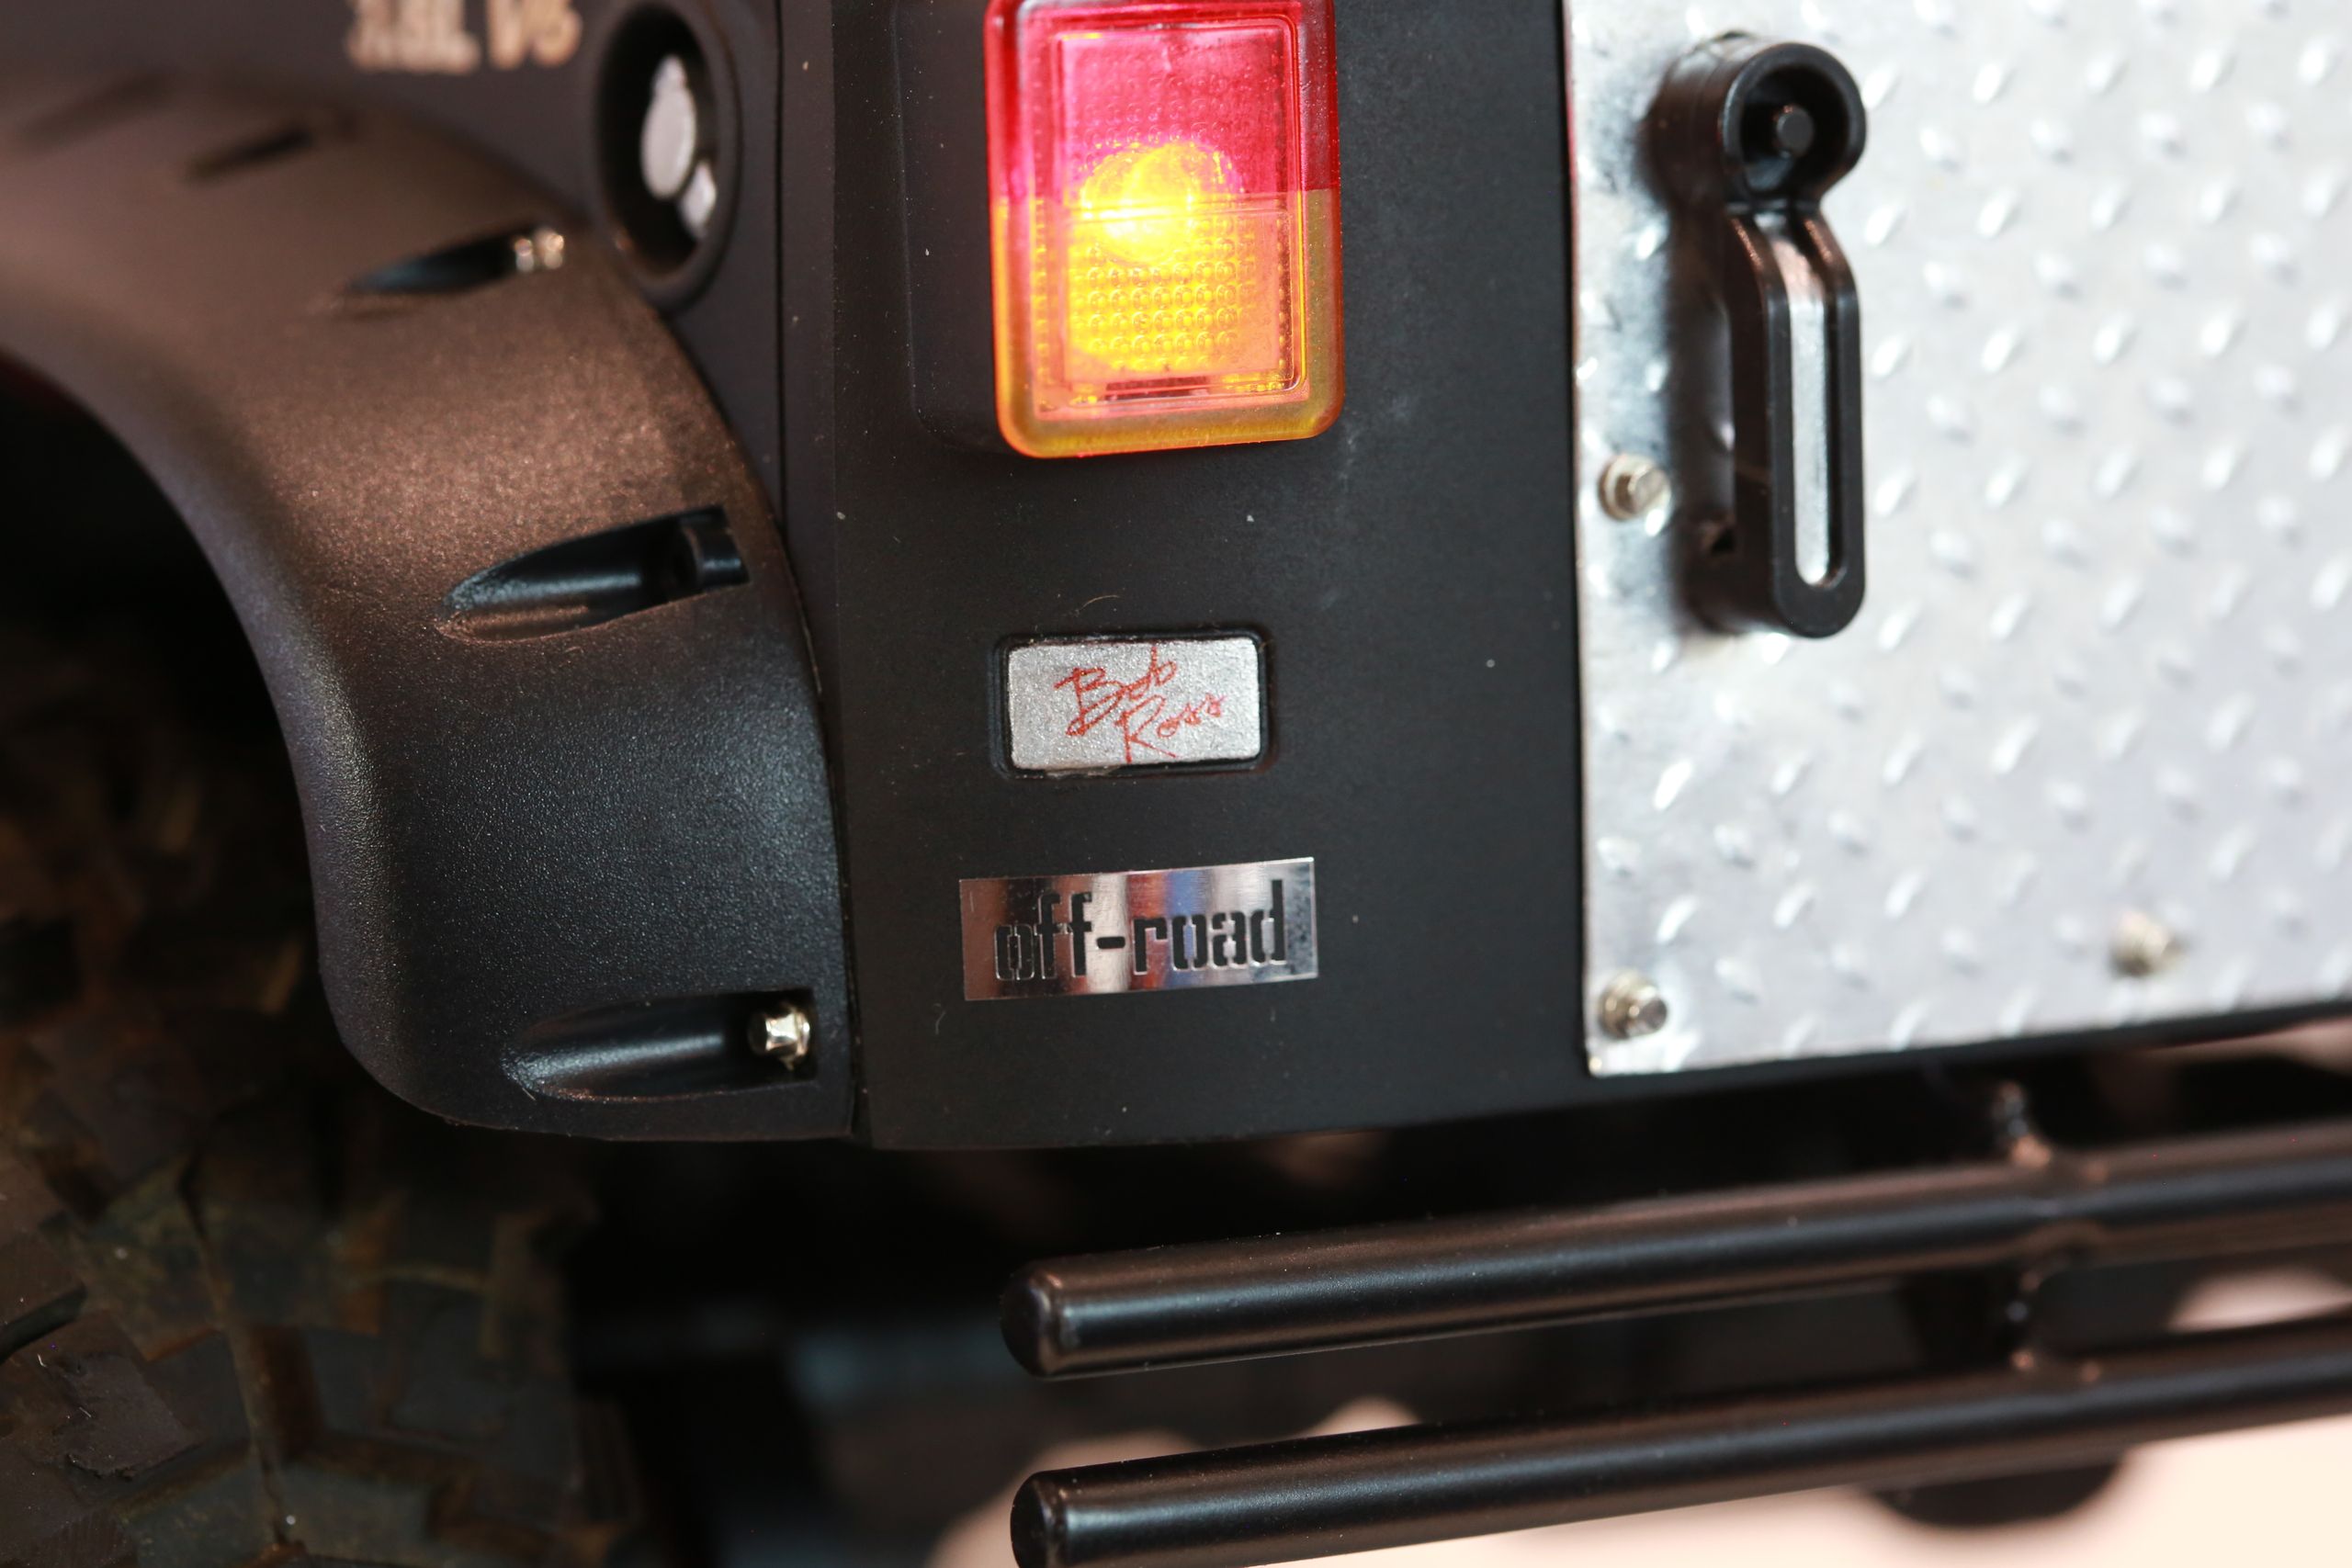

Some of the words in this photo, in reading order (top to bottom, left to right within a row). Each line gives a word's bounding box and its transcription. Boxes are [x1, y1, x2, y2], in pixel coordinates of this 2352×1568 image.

[1054, 646, 1177, 736] Bob
[1114, 694, 1227, 763] Ross
[994, 879, 1286, 981] off-road
